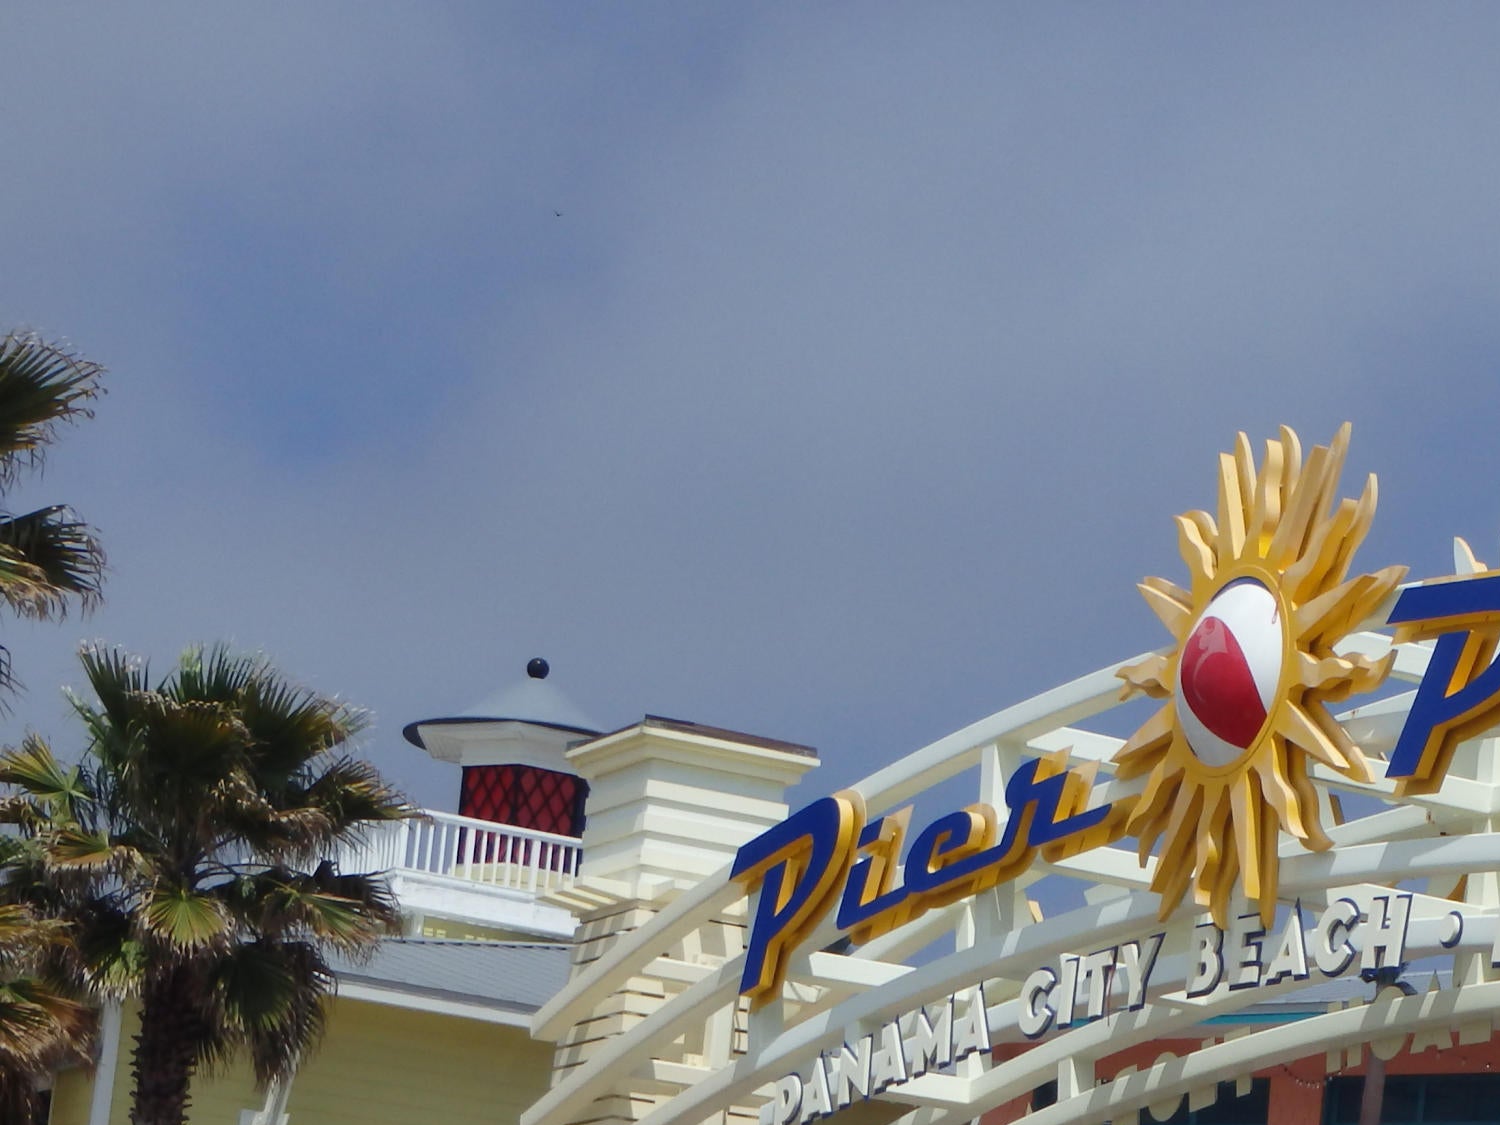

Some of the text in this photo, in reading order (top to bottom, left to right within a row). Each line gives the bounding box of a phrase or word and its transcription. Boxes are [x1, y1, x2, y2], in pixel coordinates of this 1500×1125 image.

[730, 755, 1140, 1008] Pier
[1018, 932, 1165, 1039] CITY
[1186, 893, 1413, 1000] BEACH
